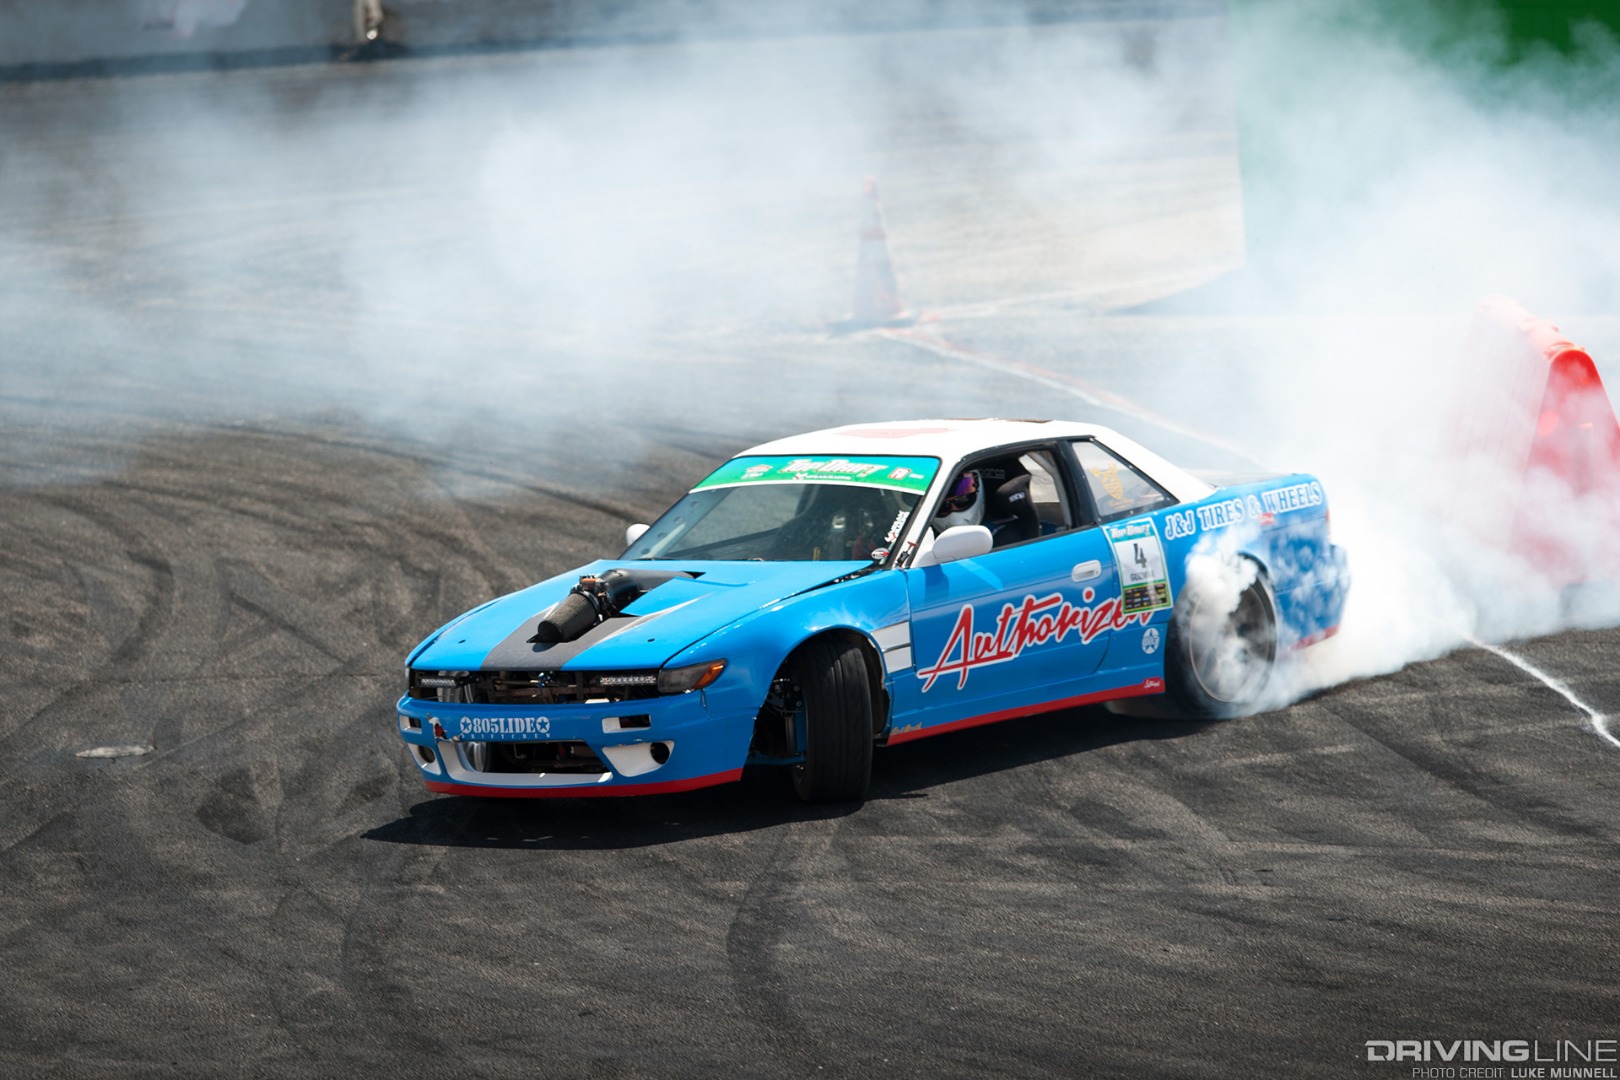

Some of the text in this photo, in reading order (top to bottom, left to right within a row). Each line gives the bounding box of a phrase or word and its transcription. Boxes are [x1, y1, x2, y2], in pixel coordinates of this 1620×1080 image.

[1165, 511, 1196, 540] J&J
[1197, 499, 1244, 531] TIRES
[1262, 482, 1323, 514] WHEELS
[1133, 543, 1148, 568] 4
[473, 716, 536, 734] 805LIDE
